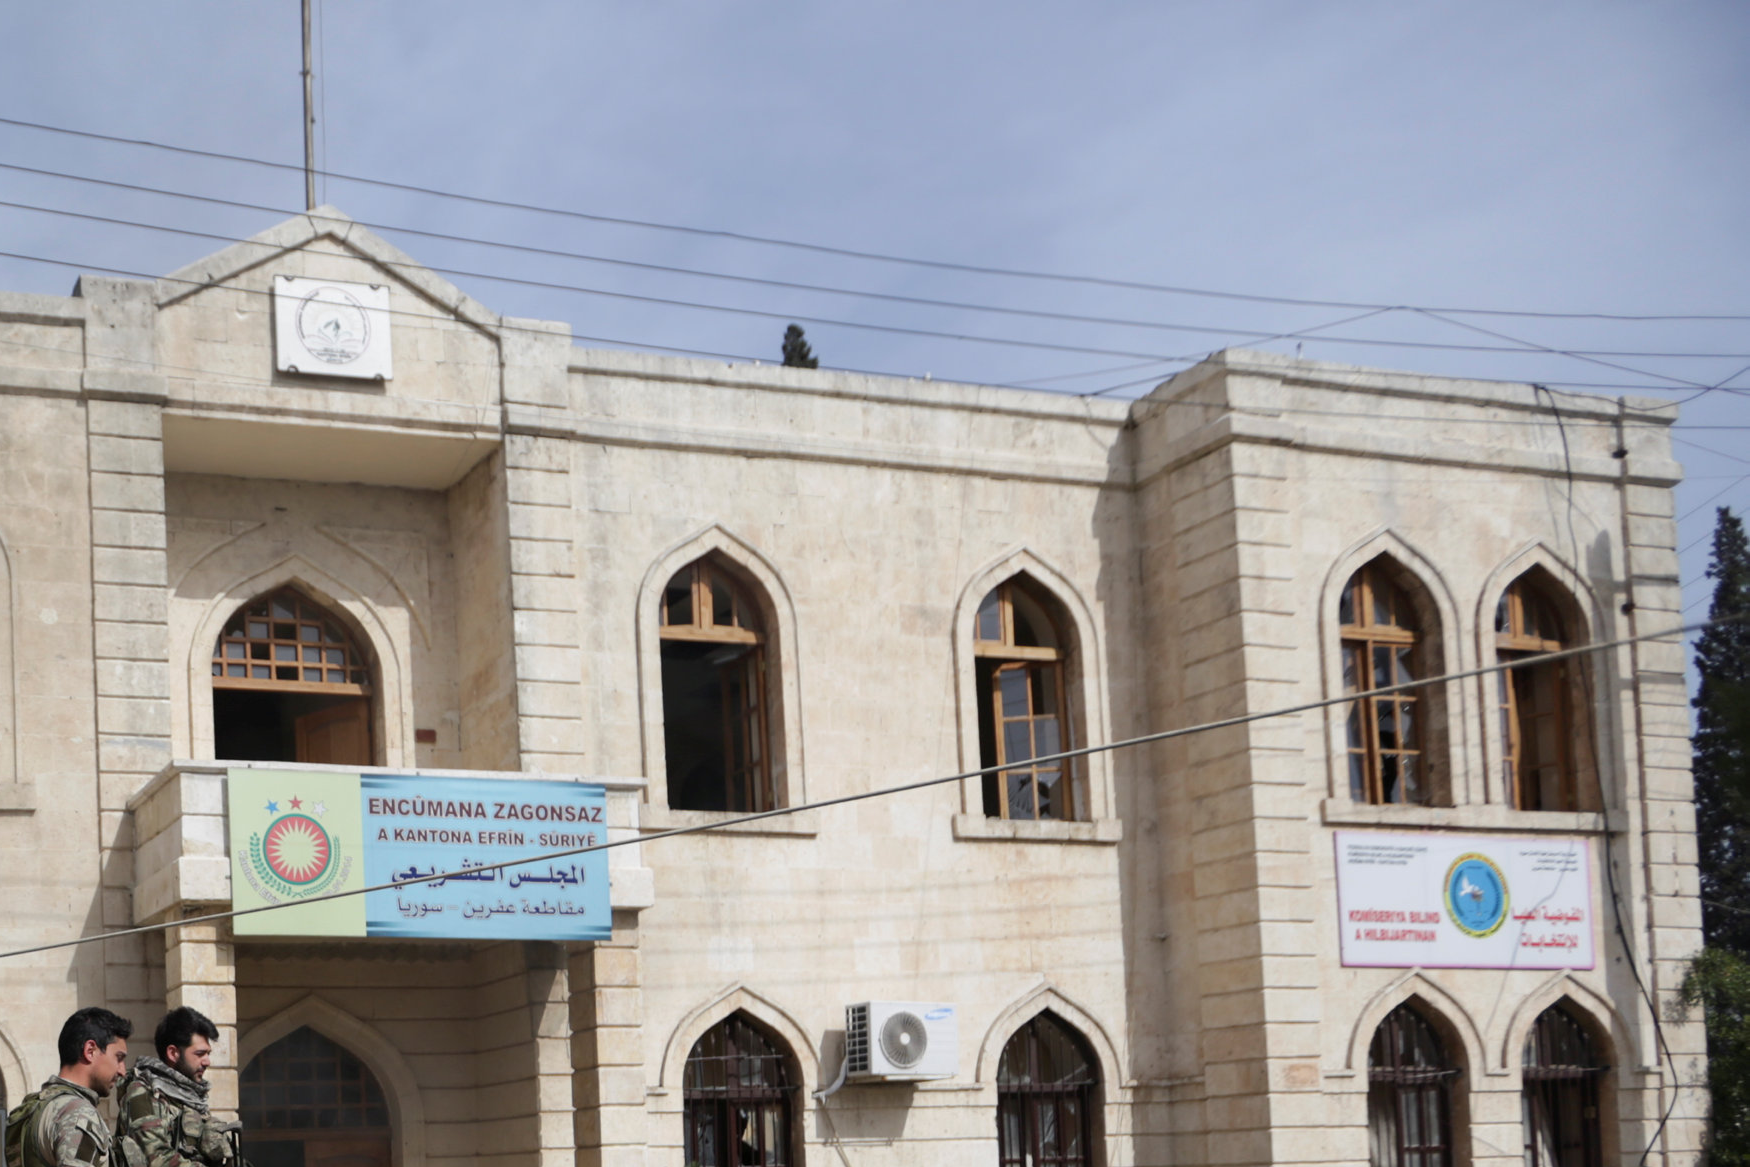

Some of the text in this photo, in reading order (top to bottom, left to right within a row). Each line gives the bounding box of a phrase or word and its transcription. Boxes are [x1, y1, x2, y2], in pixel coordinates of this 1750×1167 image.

[368, 795, 603, 823] ENCÛMANA ZAGONSAZ
[377, 828, 389, 841] A
[393, 828, 473, 843] KANTONA
[391, 858, 585, 890] المجلس التشريعي
[397, 896, 444, 918] سوريا
[462, 899, 516, 919] عفرين
[521, 899, 585, 916] مقاطعة
